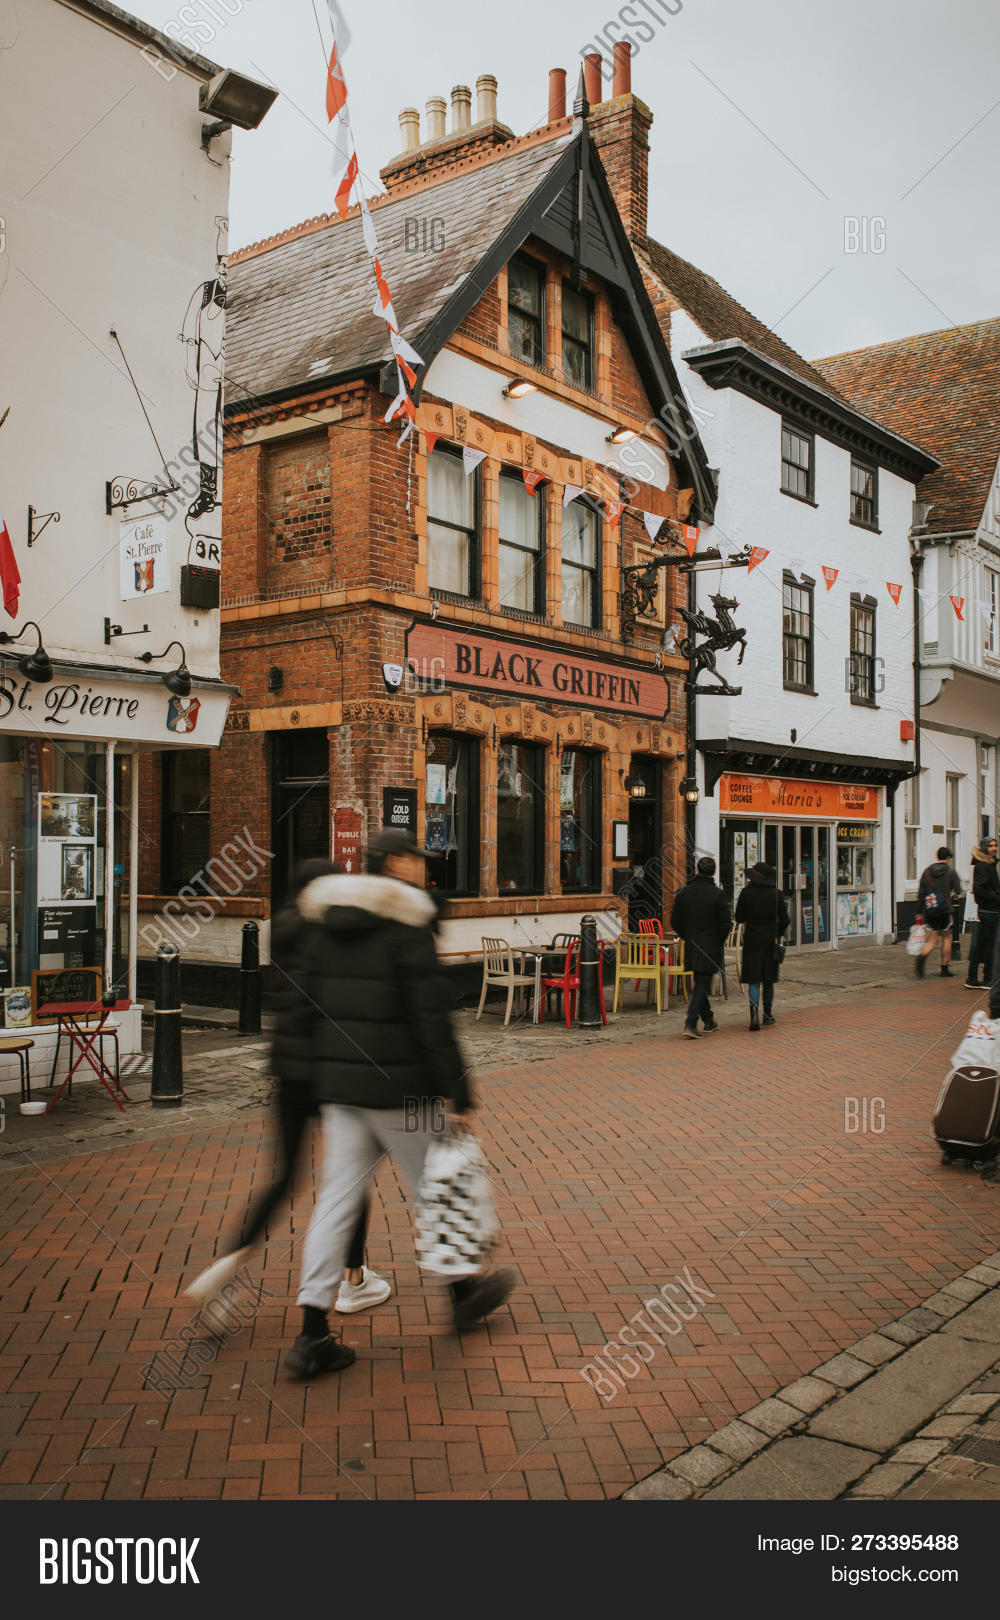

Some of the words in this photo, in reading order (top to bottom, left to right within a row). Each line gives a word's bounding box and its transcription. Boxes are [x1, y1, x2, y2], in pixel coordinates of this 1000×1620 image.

[135, 524, 153, 540] Café
[126, 545, 138, 560] St.
[138, 542, 162, 558] Pierre
[455, 643, 543, 687] BLACK
[552, 662, 641, 706] GRIFFIN
[0, 677, 32, 718] St.
[45, 684, 139, 724] Pierre
[730, 783, 752, 793] COFFEE
[730, 794, 752, 804] LOUNGE
[772, 783, 822, 808] Maria's
[393, 804, 409, 815] COLD
[391, 814, 410, 824] OUTSIDE
[337, 831, 359, 839] PUBLIC
[837, 827, 848, 838] ICE
